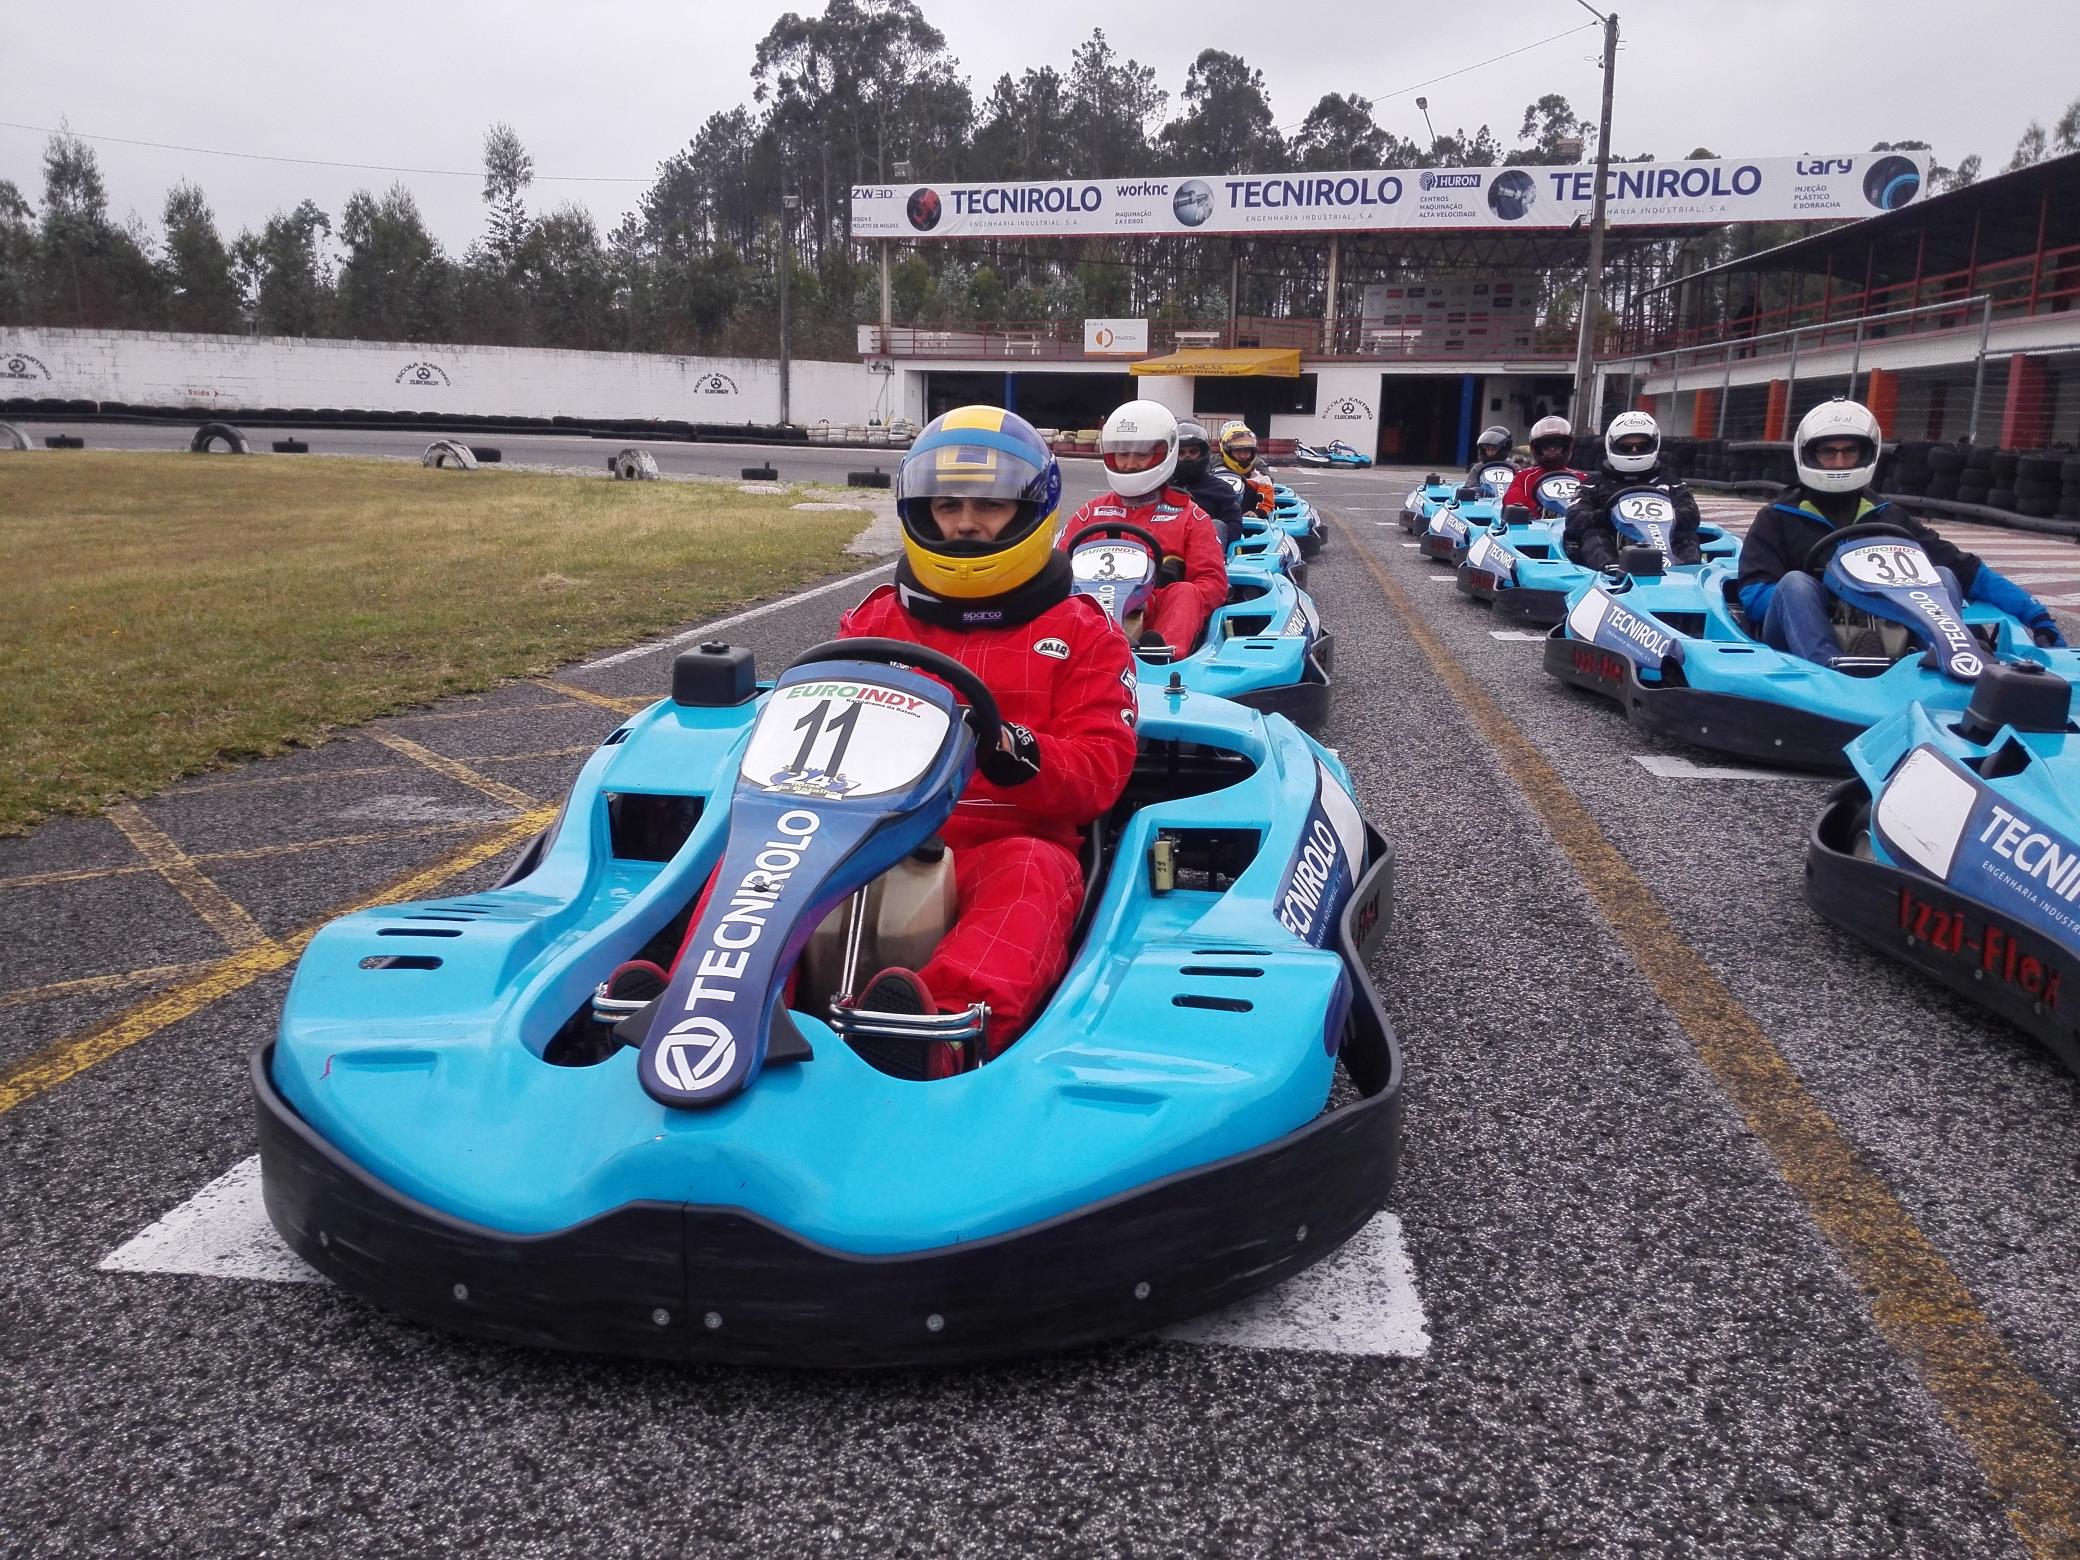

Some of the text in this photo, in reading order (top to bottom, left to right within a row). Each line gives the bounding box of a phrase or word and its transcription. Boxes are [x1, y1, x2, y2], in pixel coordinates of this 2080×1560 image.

[1116, 180, 1169, 197] worknc
[1440, 175, 1478, 187] HURON
[950, 185, 1102, 214] TECNIROLO
[1225, 176, 1403, 208] TECNIROLO
[1419, 203, 1463, 211] MAQUINAÇÃO
[1799, 201, 1841, 209] BORRACHA
[1114, 210, 1152, 218] MAQUINAÇÃO
[1246, 214, 1298, 223] ENGENHARIA
[969, 220, 1015, 228] ENGENHARIA
[395, 361, 451, 387] ESCOLA KARTING
[715, 372, 739, 395] KARTING
[1321, 396, 1374, 421] ESCOLA KARTING
[1493, 471, 1505, 482] 17
[1553, 481, 1578, 496] 25
[1631, 500, 1664, 517] 26
[1081, 546, 1139, 557] EUROINDY
[1854, 546, 1918, 557] EUROINDY
[1098, 552, 1116, 577] 3
[1867, 551, 1920, 580] 30
[963, 610, 1003, 621] sparco
[1908, 591, 1971, 652] TECNIROLO
[1607, 605, 1671, 658] TECNIROLO
[786, 684, 926, 711] EUROINDY
[896, 707, 921, 719] Batalha
[793, 699, 863, 778] 11
[1982, 860, 2039, 904] ENGENHARIA
[684, 808, 822, 1003] TECNIROLO
